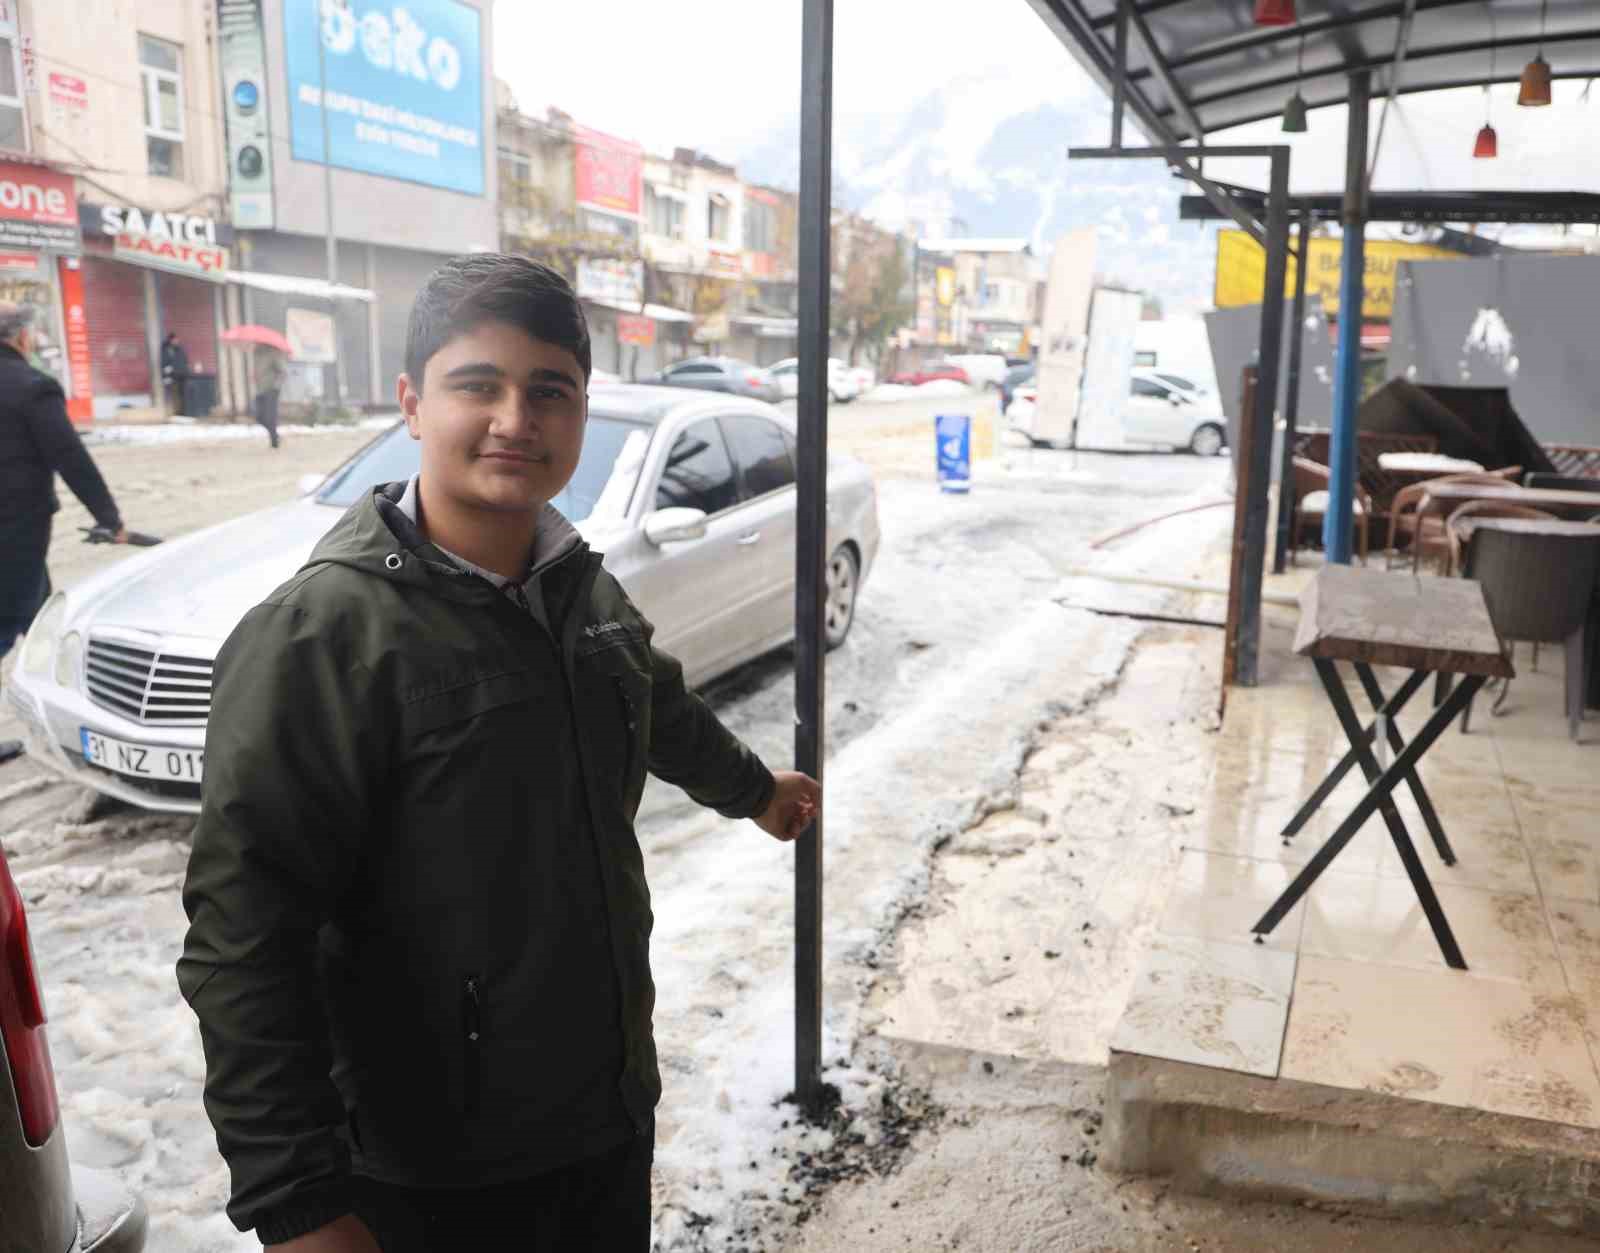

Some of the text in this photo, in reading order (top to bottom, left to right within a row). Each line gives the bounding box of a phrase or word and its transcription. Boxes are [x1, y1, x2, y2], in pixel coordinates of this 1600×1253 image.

[320, 0, 460, 91] beko
[89, 735, 107, 762] 31
[118, 744, 151, 774] NZ
